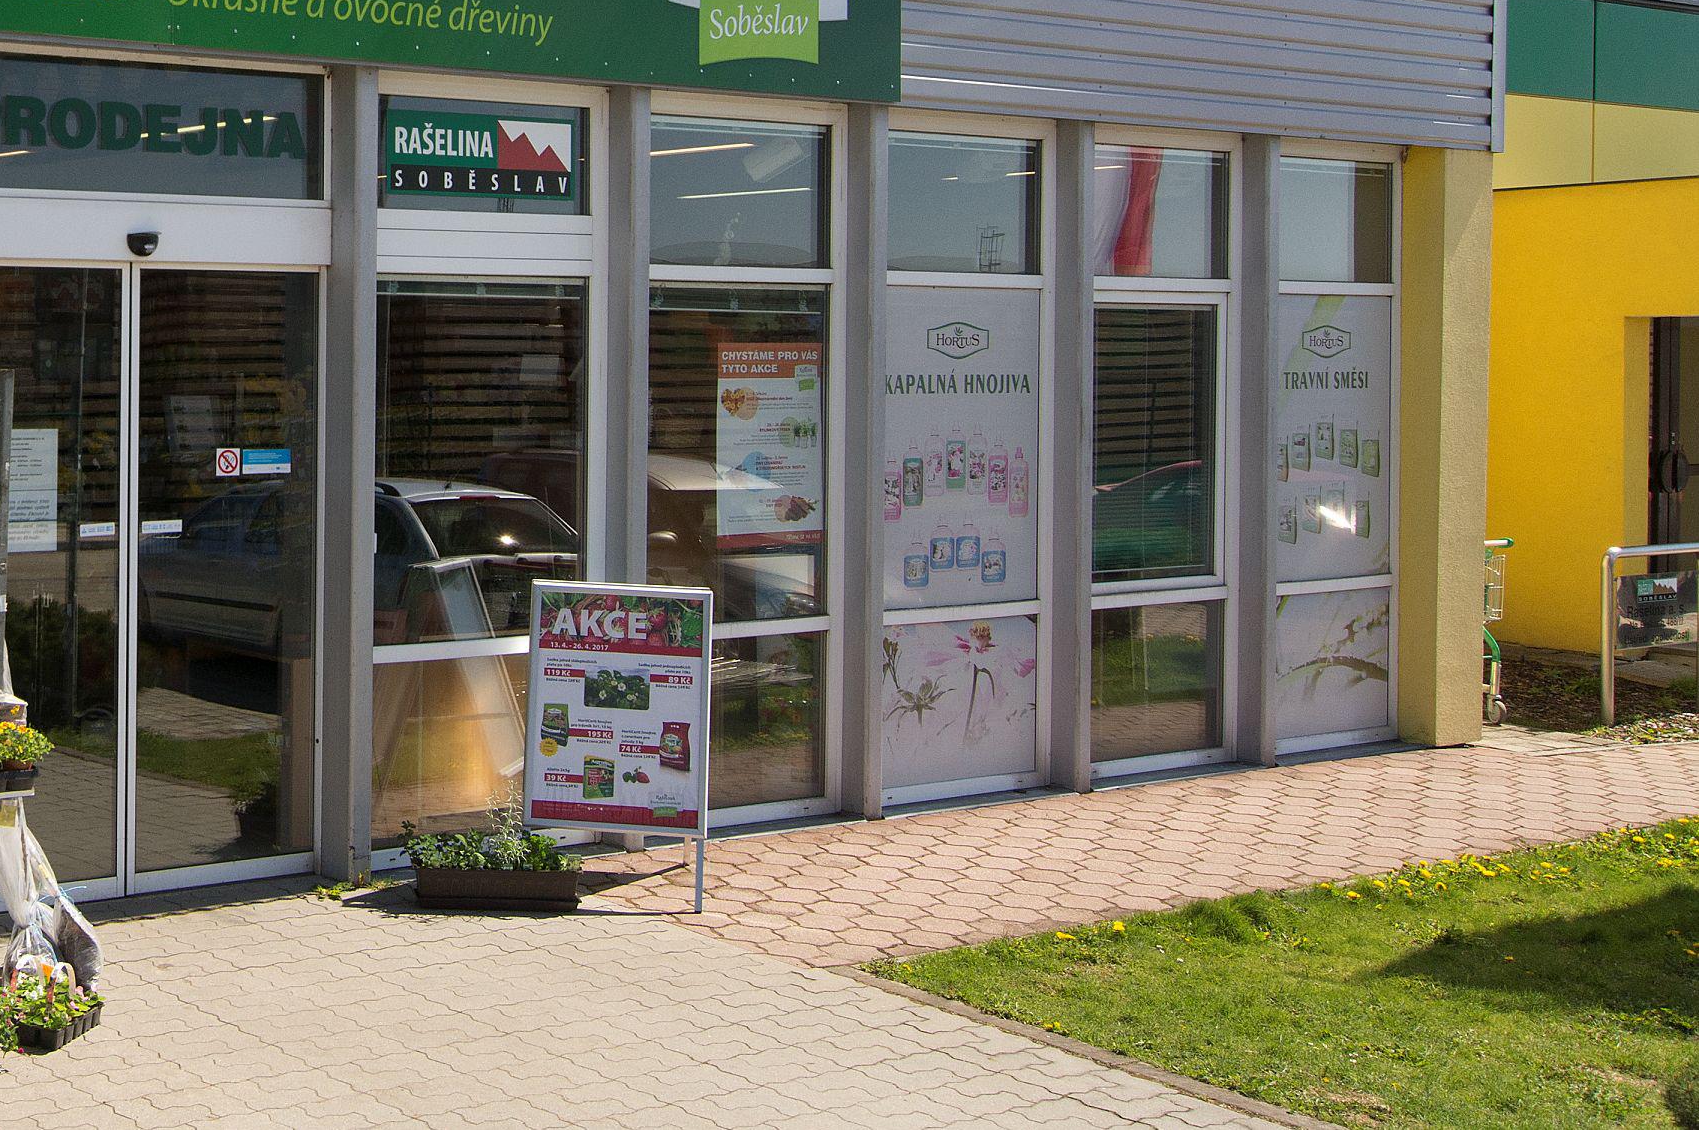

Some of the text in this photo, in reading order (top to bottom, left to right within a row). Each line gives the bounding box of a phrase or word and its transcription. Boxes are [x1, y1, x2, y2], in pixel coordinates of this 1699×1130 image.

[709, 3, 809, 39] Soběslav
[394, 121, 494, 159] RAŠELINA
[722, 350, 818, 361] CHYSTÁME PRO VÁS
[722, 364, 778, 373] TYTO AKCE
[885, 368, 1031, 395] KAPALNÁ HNOJIVA
[1283, 366, 1369, 390] TRAVNÍ SMĚSI
[551, 608, 648, 640] AKCE
[561, 669, 571, 677] Kč
[680, 677, 690, 685] Kč
[587, 730, 601, 738] 195
[602, 731, 612, 739] Kč
